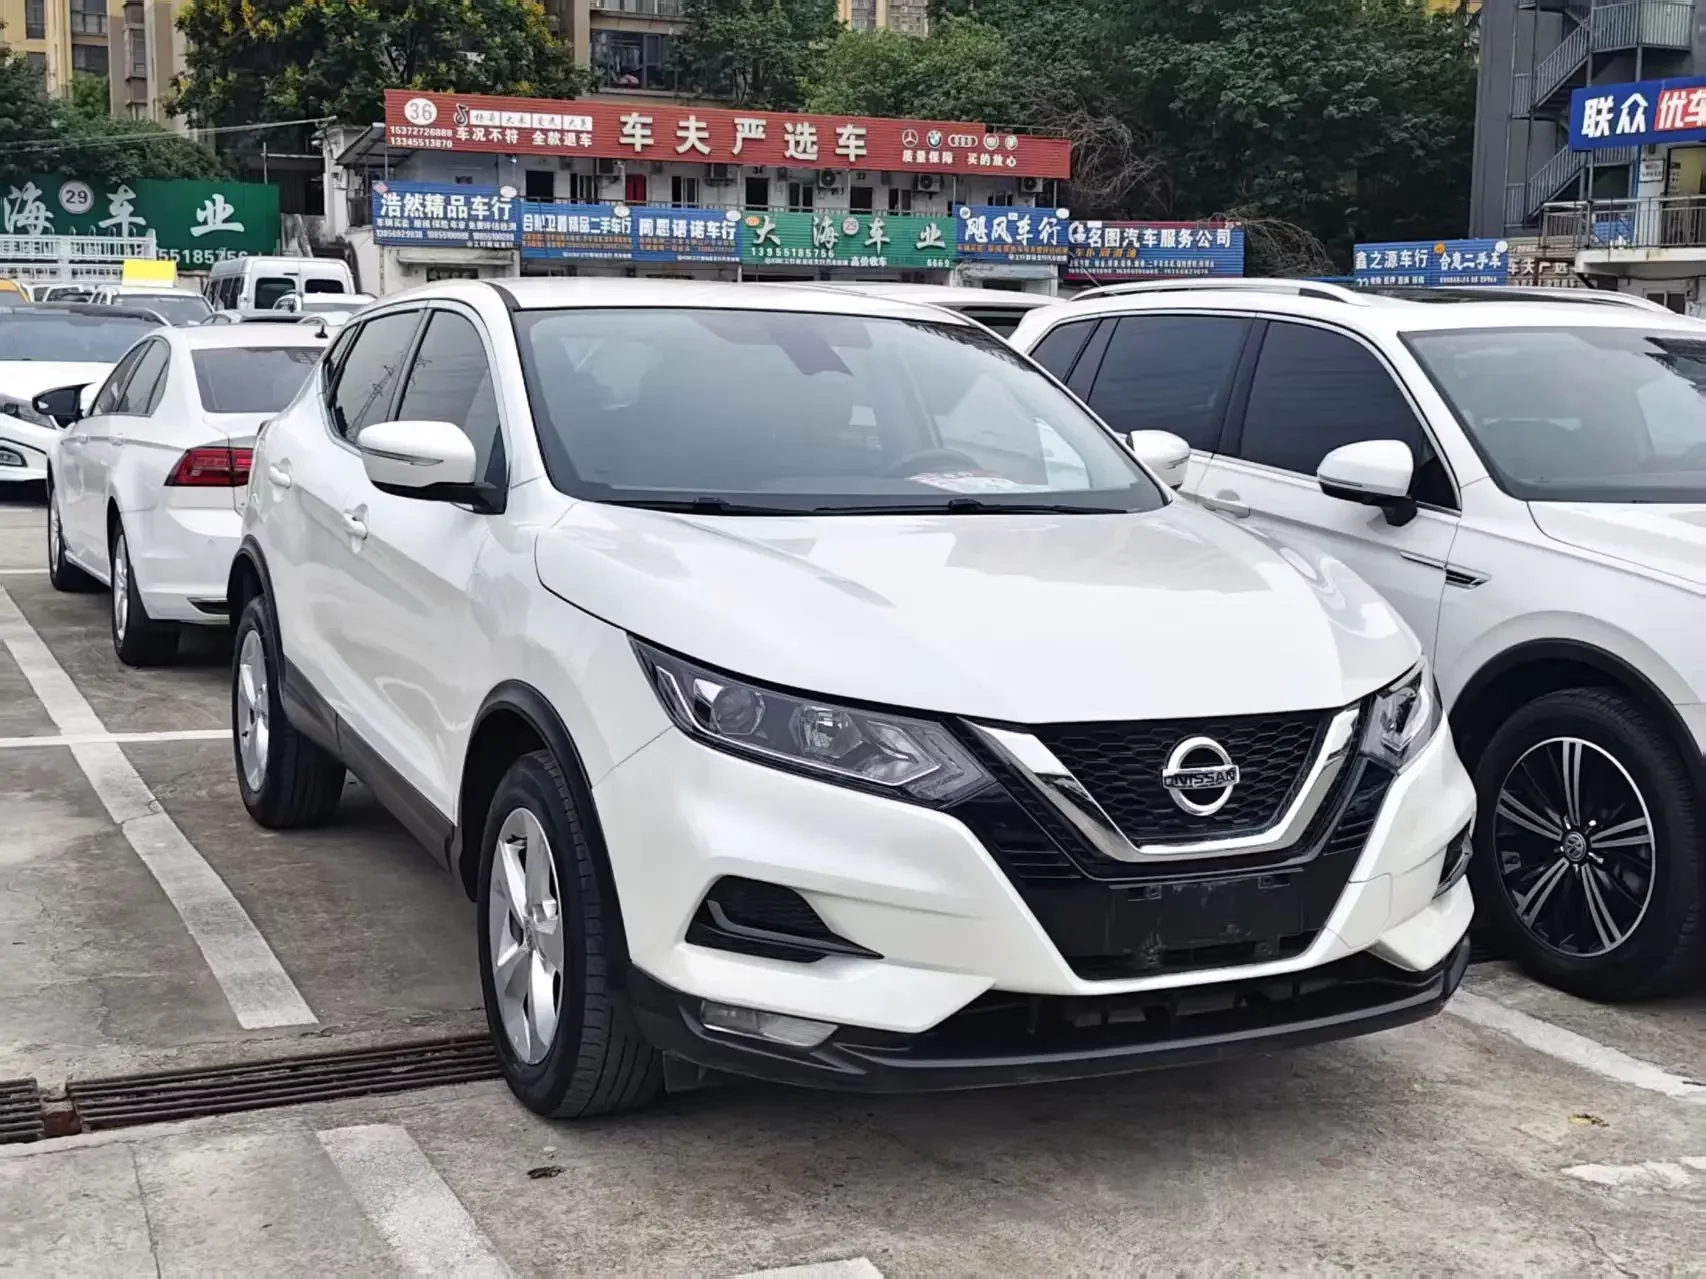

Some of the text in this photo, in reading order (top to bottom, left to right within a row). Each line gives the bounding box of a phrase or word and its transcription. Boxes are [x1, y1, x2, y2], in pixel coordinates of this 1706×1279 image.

[409, 102, 433, 121] 36
[456, 126, 593, 148] 车况不符 全款退车
[619, 112, 868, 163] 车夫严选车
[902, 149, 1017, 167] 质量保障 买的放心
[65, 190, 88, 204] 29
[380, 192, 512, 220] 浩然精品车行
[753, 215, 946, 255] 大海车业
[1088, 228, 1232, 248] 名图汽车服务公司
[751, 247, 835, 259] 13955185756
[1355, 249, 1428, 270] 鑫之源车行
[1174, 769, 1236, 788] NISSAN
